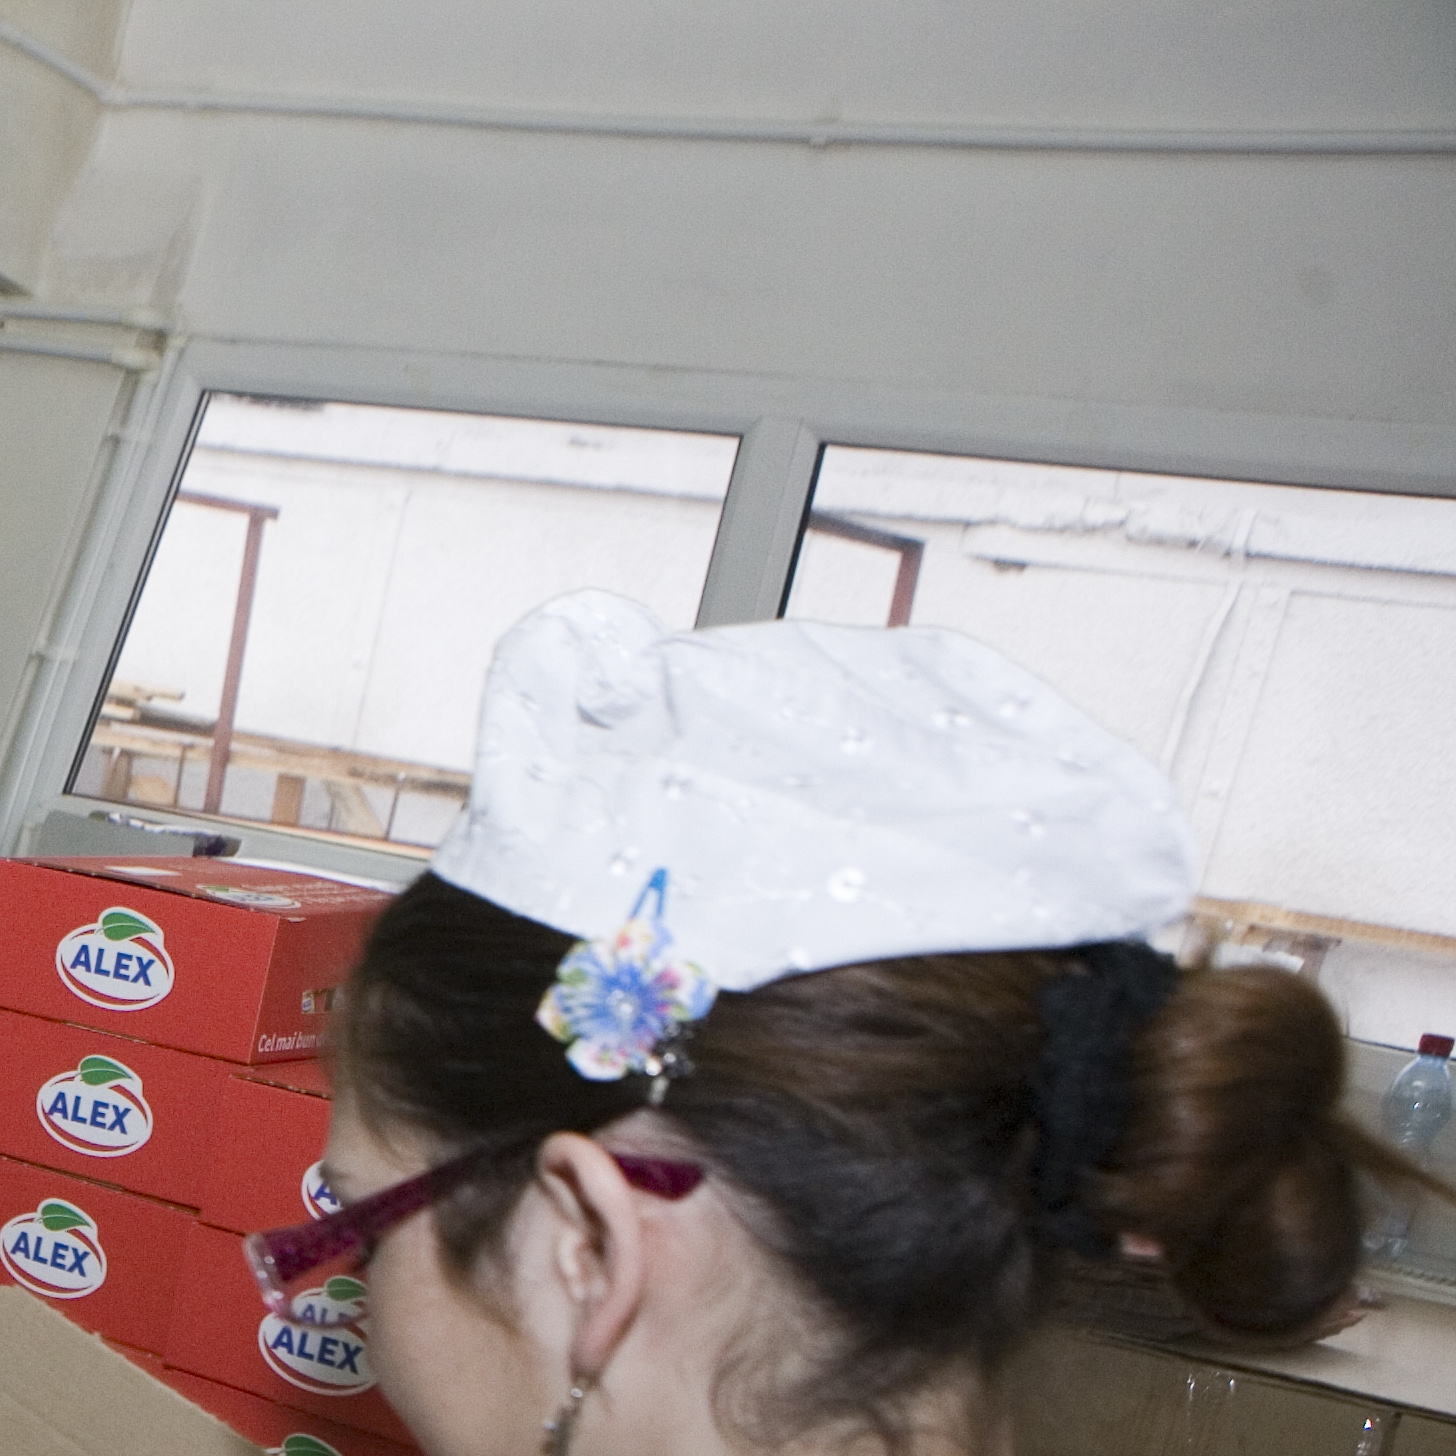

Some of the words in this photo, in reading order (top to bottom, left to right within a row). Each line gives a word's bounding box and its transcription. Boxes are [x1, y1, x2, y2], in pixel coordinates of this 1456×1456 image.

[70, 944, 155, 987] ALEX
[258, 1033, 276, 1053] Cel
[275, 1031, 297, 1052] mai
[48, 1091, 131, 1135] ALEX
[10, 1231, 91, 1278] ALEX
[271, 1325, 363, 1375] ALEX
